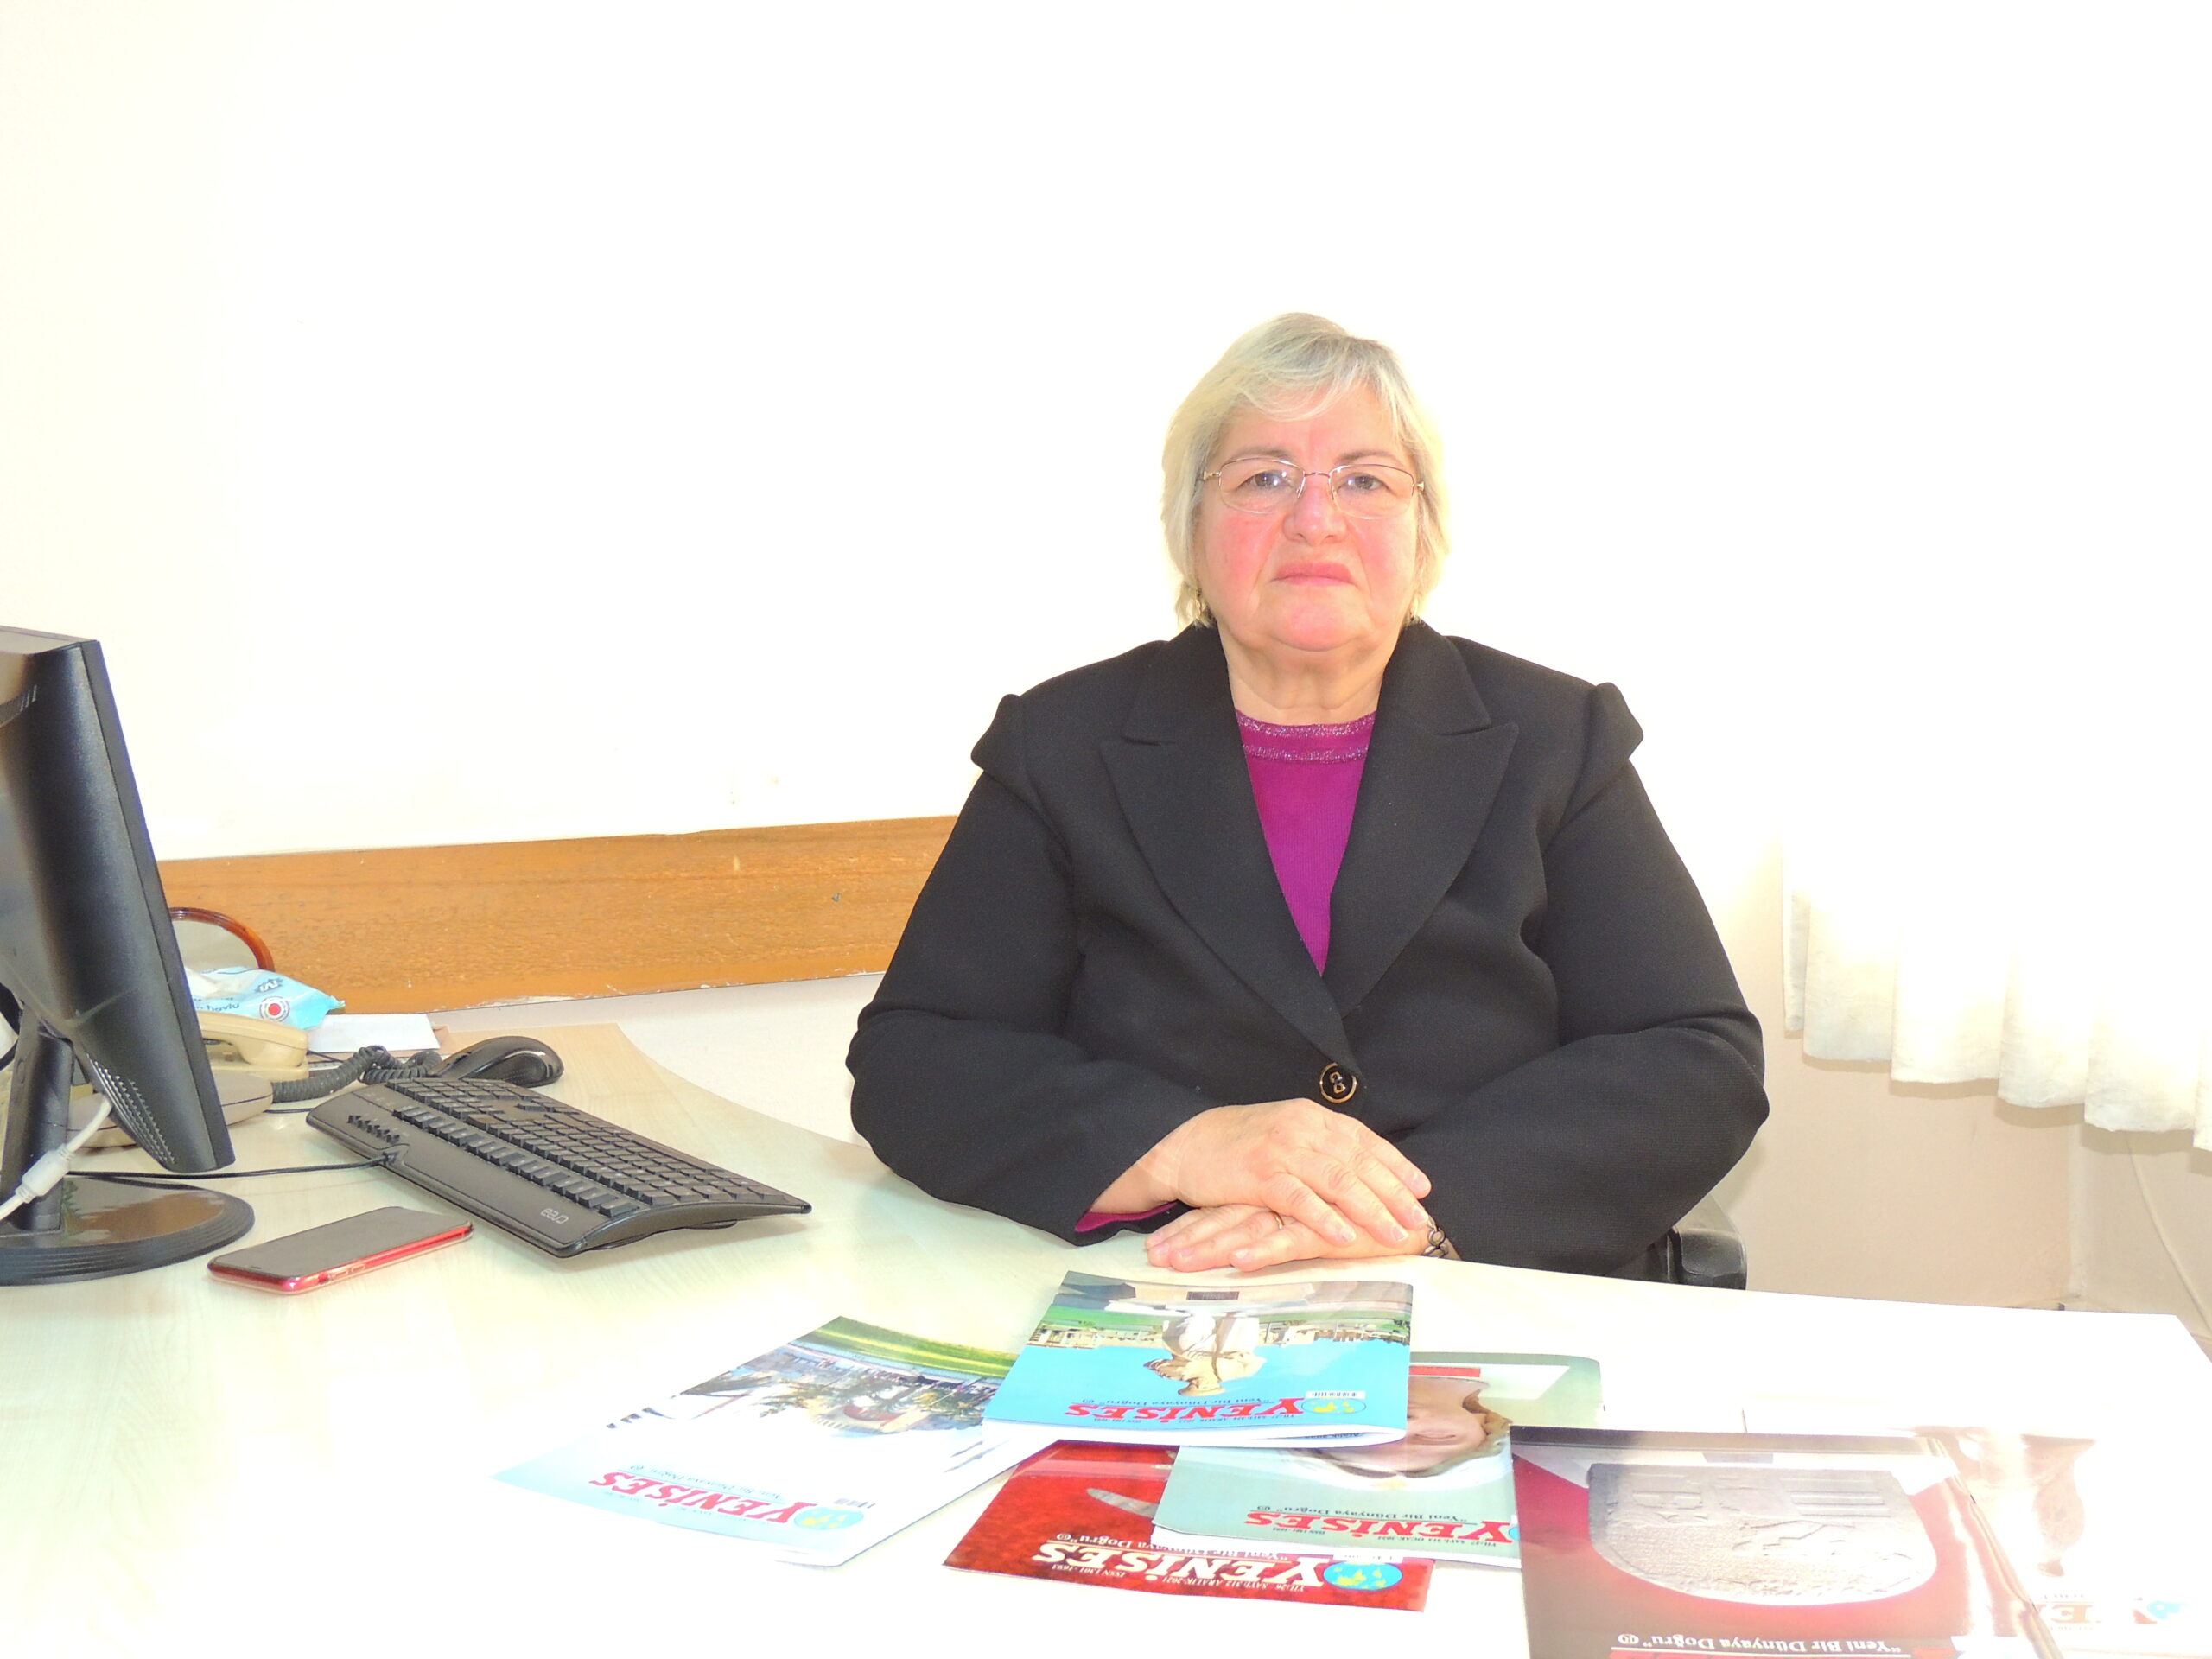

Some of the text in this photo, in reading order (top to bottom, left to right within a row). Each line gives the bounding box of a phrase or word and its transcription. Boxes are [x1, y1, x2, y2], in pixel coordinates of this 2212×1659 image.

[1244, 1511, 1513, 1543] YENİSES
[1031, 1543, 1331, 1588] YENİSES
[1719, 1637, 1807, 1652] Dünyaya
[1811, 1640, 1842, 1652] Bir
